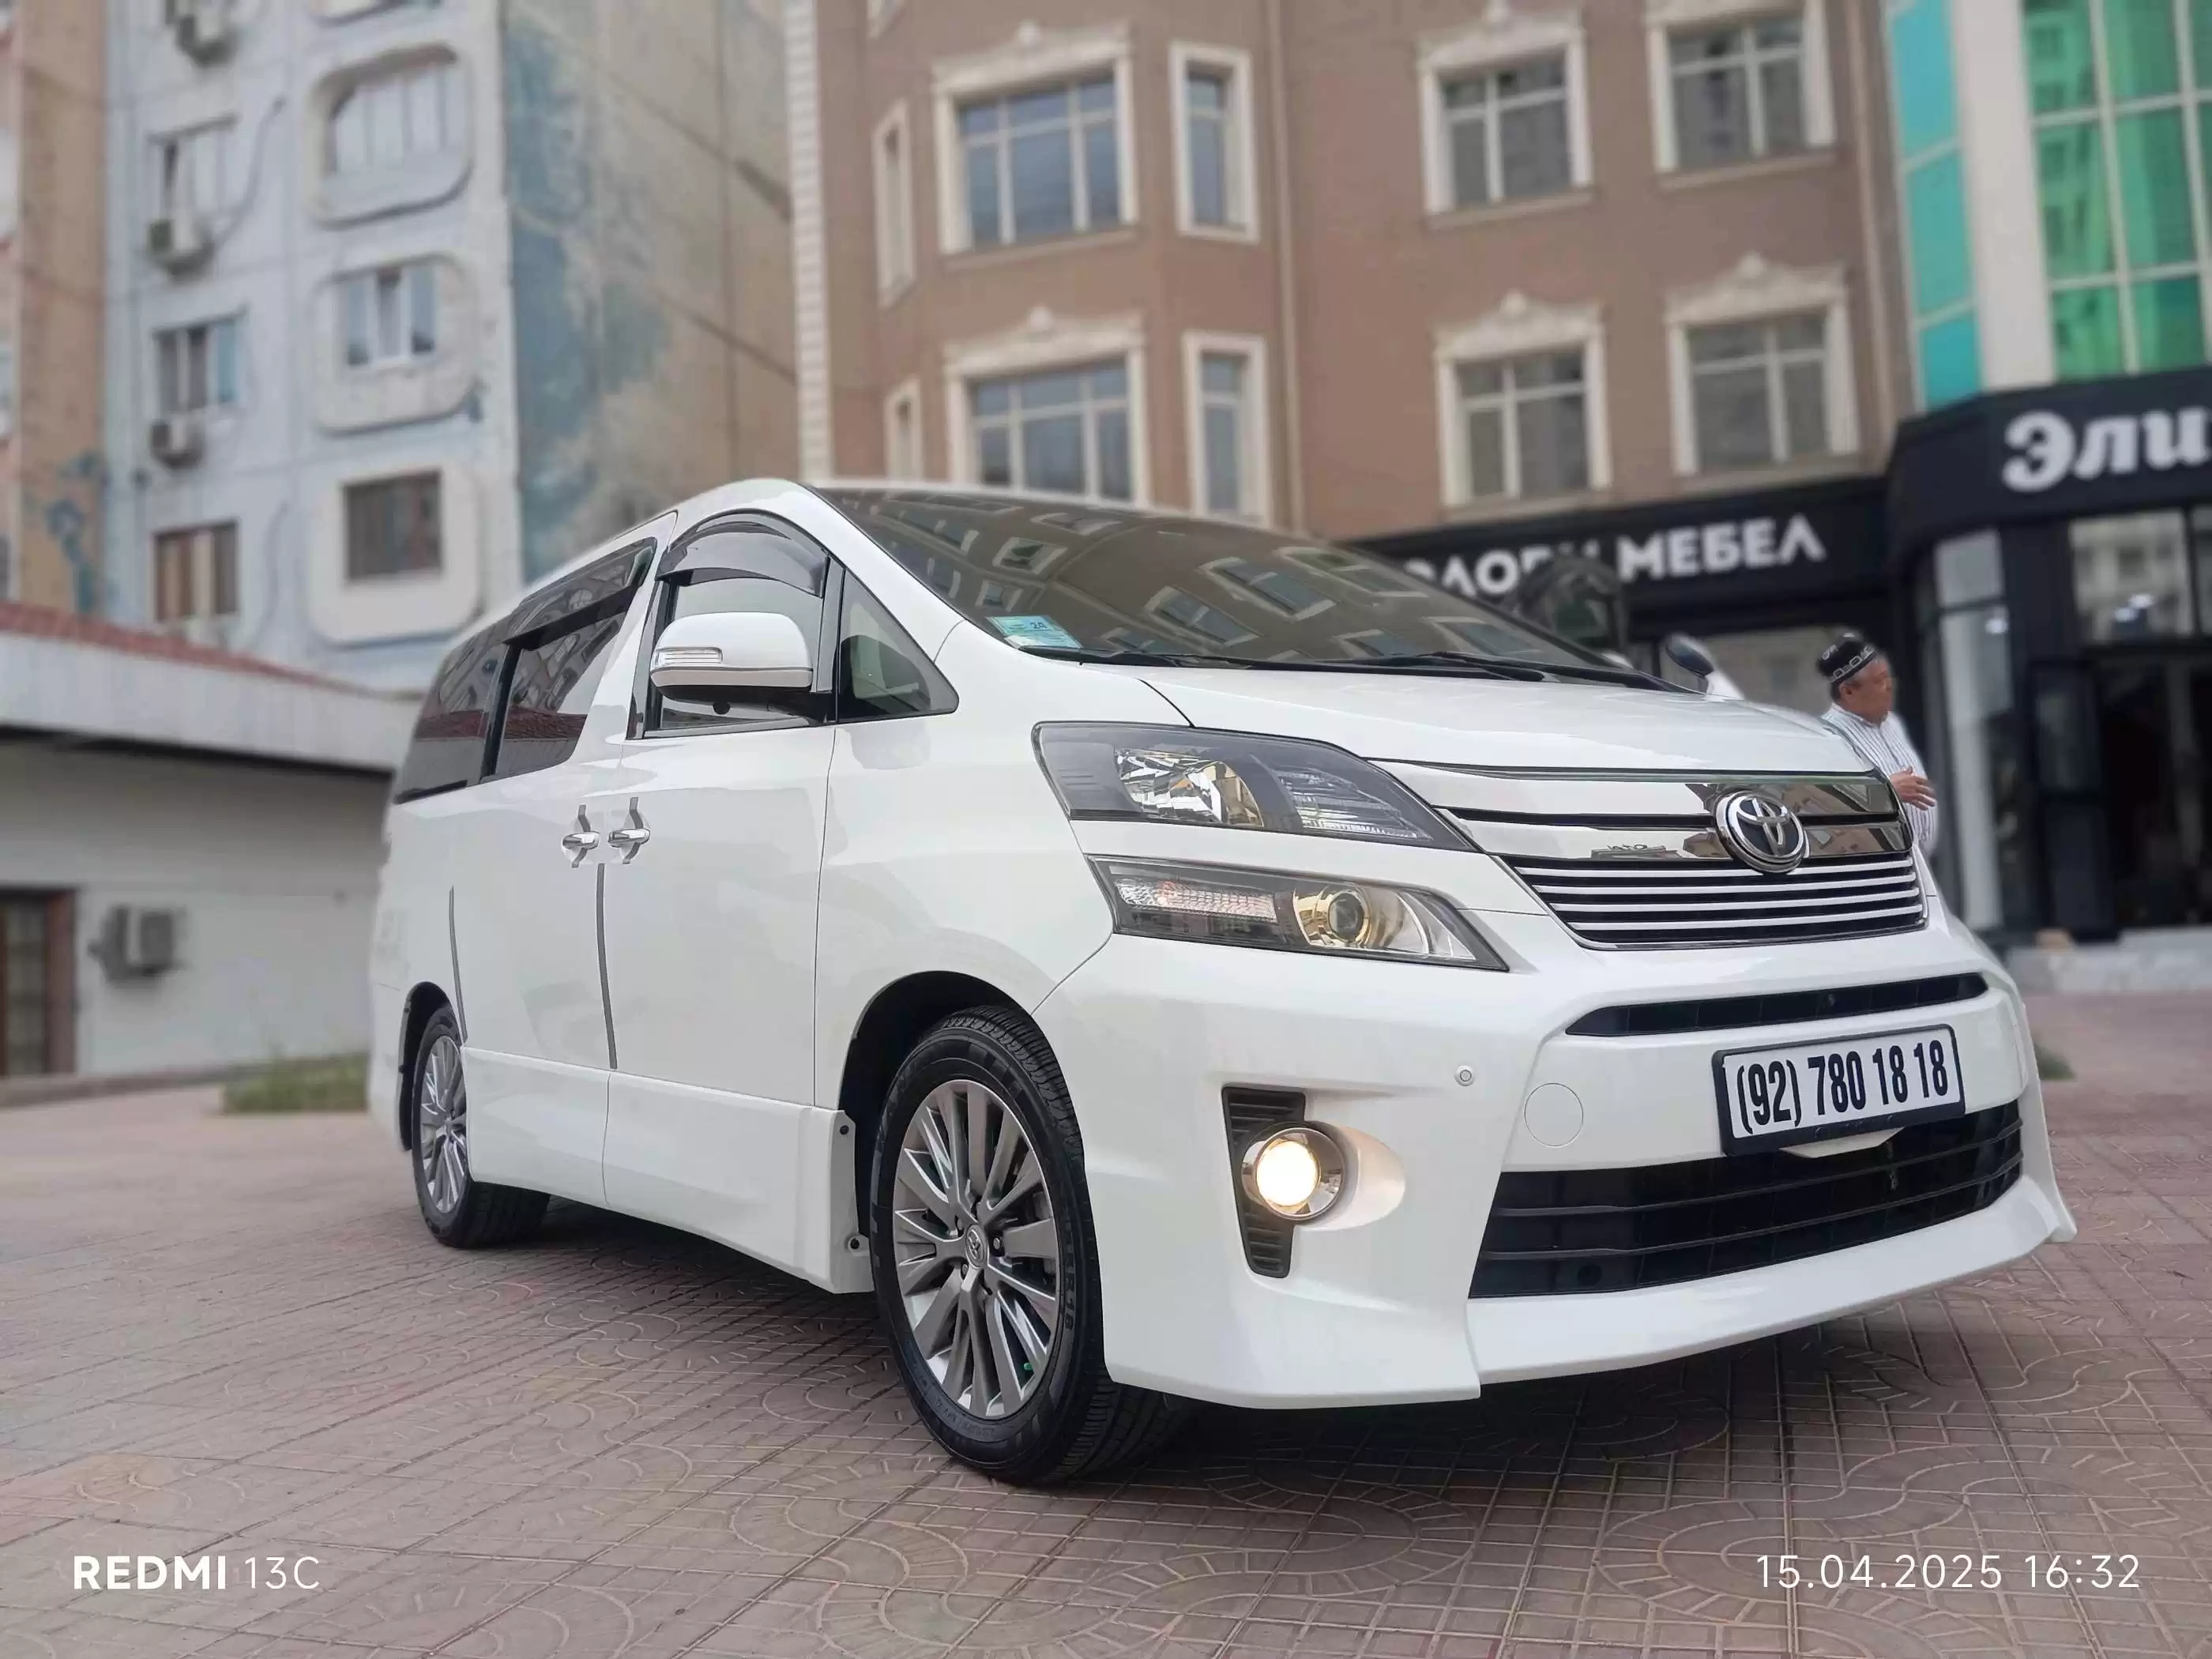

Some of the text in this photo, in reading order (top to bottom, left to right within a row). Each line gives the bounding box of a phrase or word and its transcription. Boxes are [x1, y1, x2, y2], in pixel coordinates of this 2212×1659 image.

[2002, 406, 2210, 493] Эли
[1616, 516, 1825, 581] МЕБЕЛ
[1736, 1040, 1948, 1134] (92) 780 18 18
